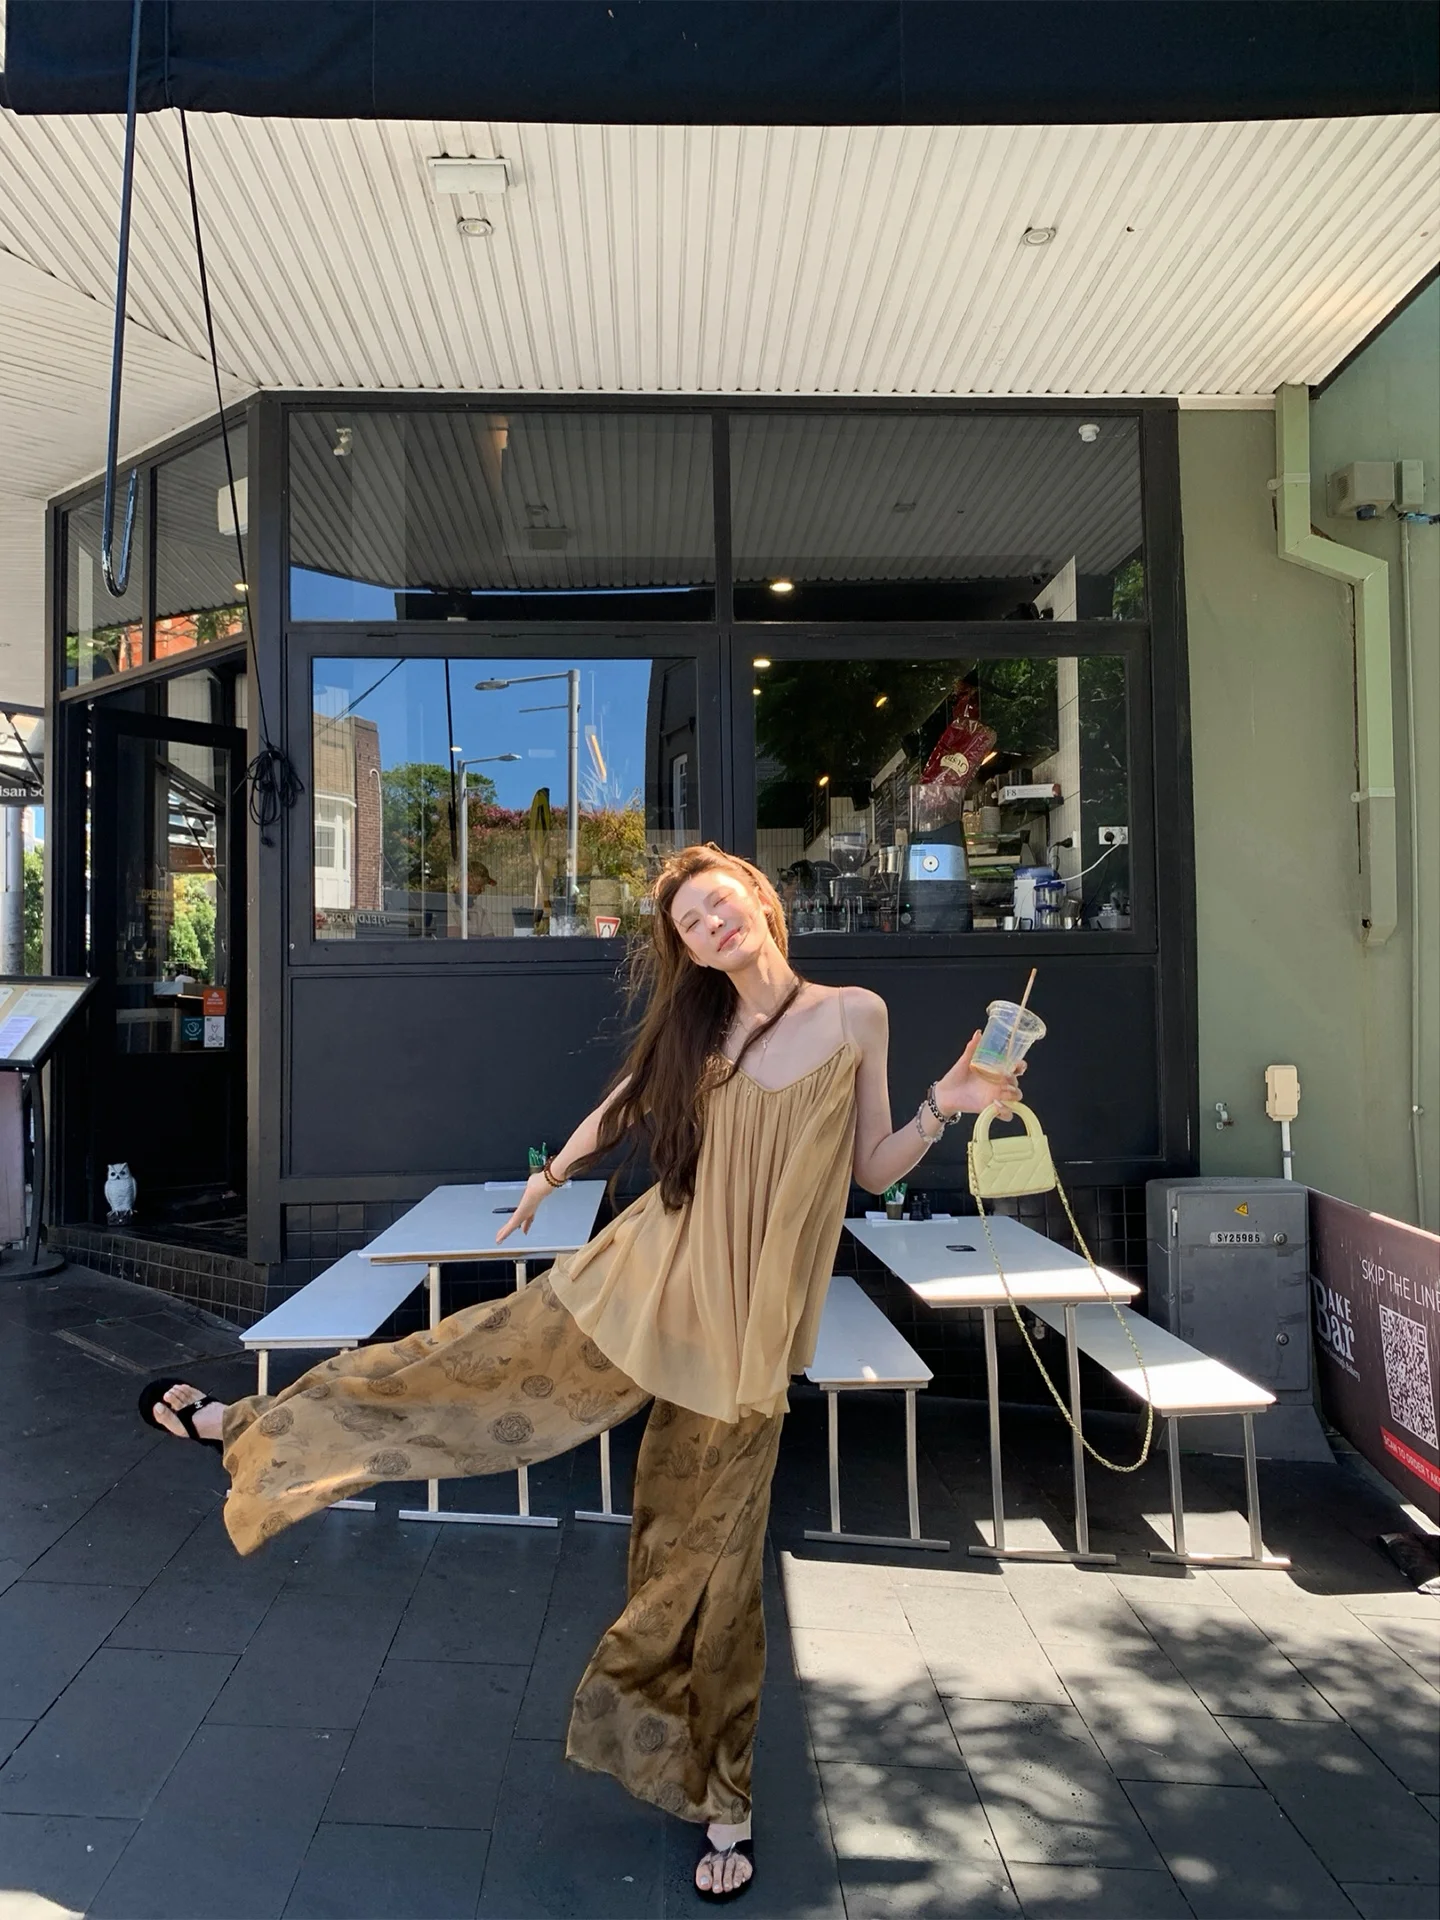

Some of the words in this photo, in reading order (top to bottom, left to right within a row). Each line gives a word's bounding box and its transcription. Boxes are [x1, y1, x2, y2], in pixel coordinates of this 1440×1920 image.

[1217, 1233, 1260, 1243] SY25985
[1361, 1259, 1385, 1286] SKIP
[1386, 1269, 1411, 1301] THE
[1383, 1435, 1398, 1454] SCAN
[1397, 1446, 1406, 1460] TO
[1406, 1453, 1426, 1476] ORDER
